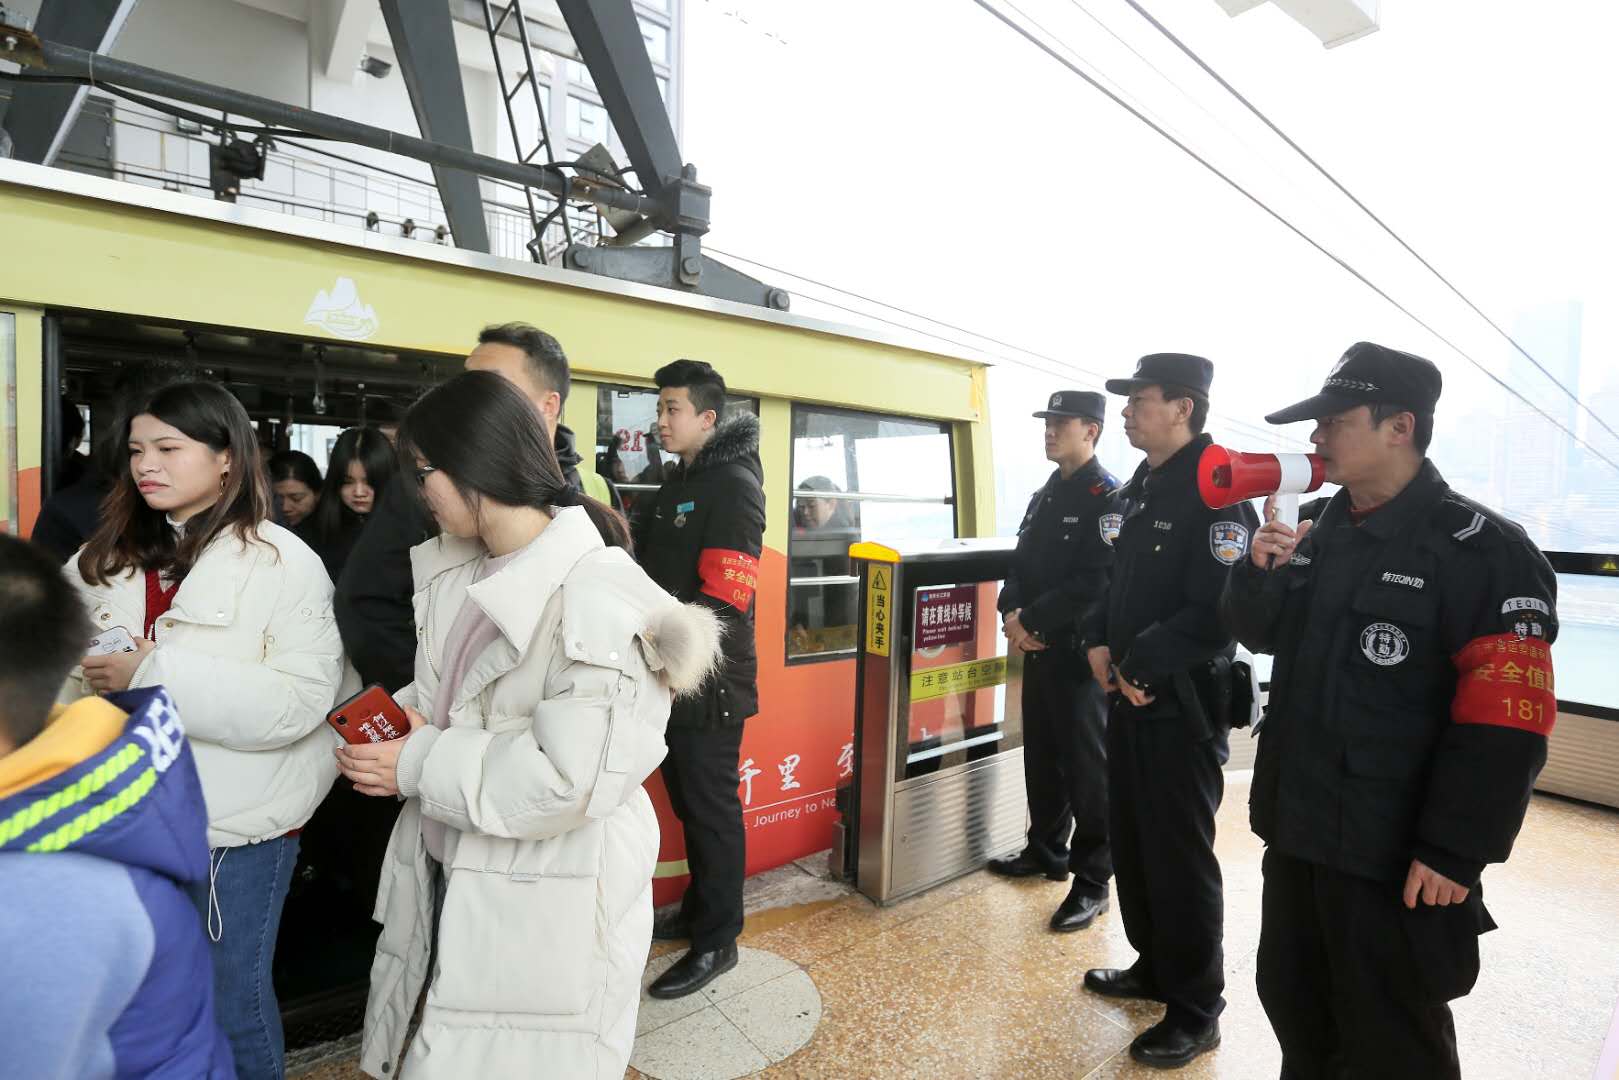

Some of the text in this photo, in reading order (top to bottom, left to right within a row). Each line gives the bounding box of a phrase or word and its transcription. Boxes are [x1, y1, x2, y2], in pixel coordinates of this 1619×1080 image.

[724, 568, 756, 589] 安全值
[922, 602, 972, 626] 请在黄线外等候
[1506, 600, 1545, 611] TEQIN
[874, 594, 886, 649] 当心夹手
[1502, 698, 1544, 723] 181
[753, 806, 801, 829] Journey
[804, 802, 818, 815] to
